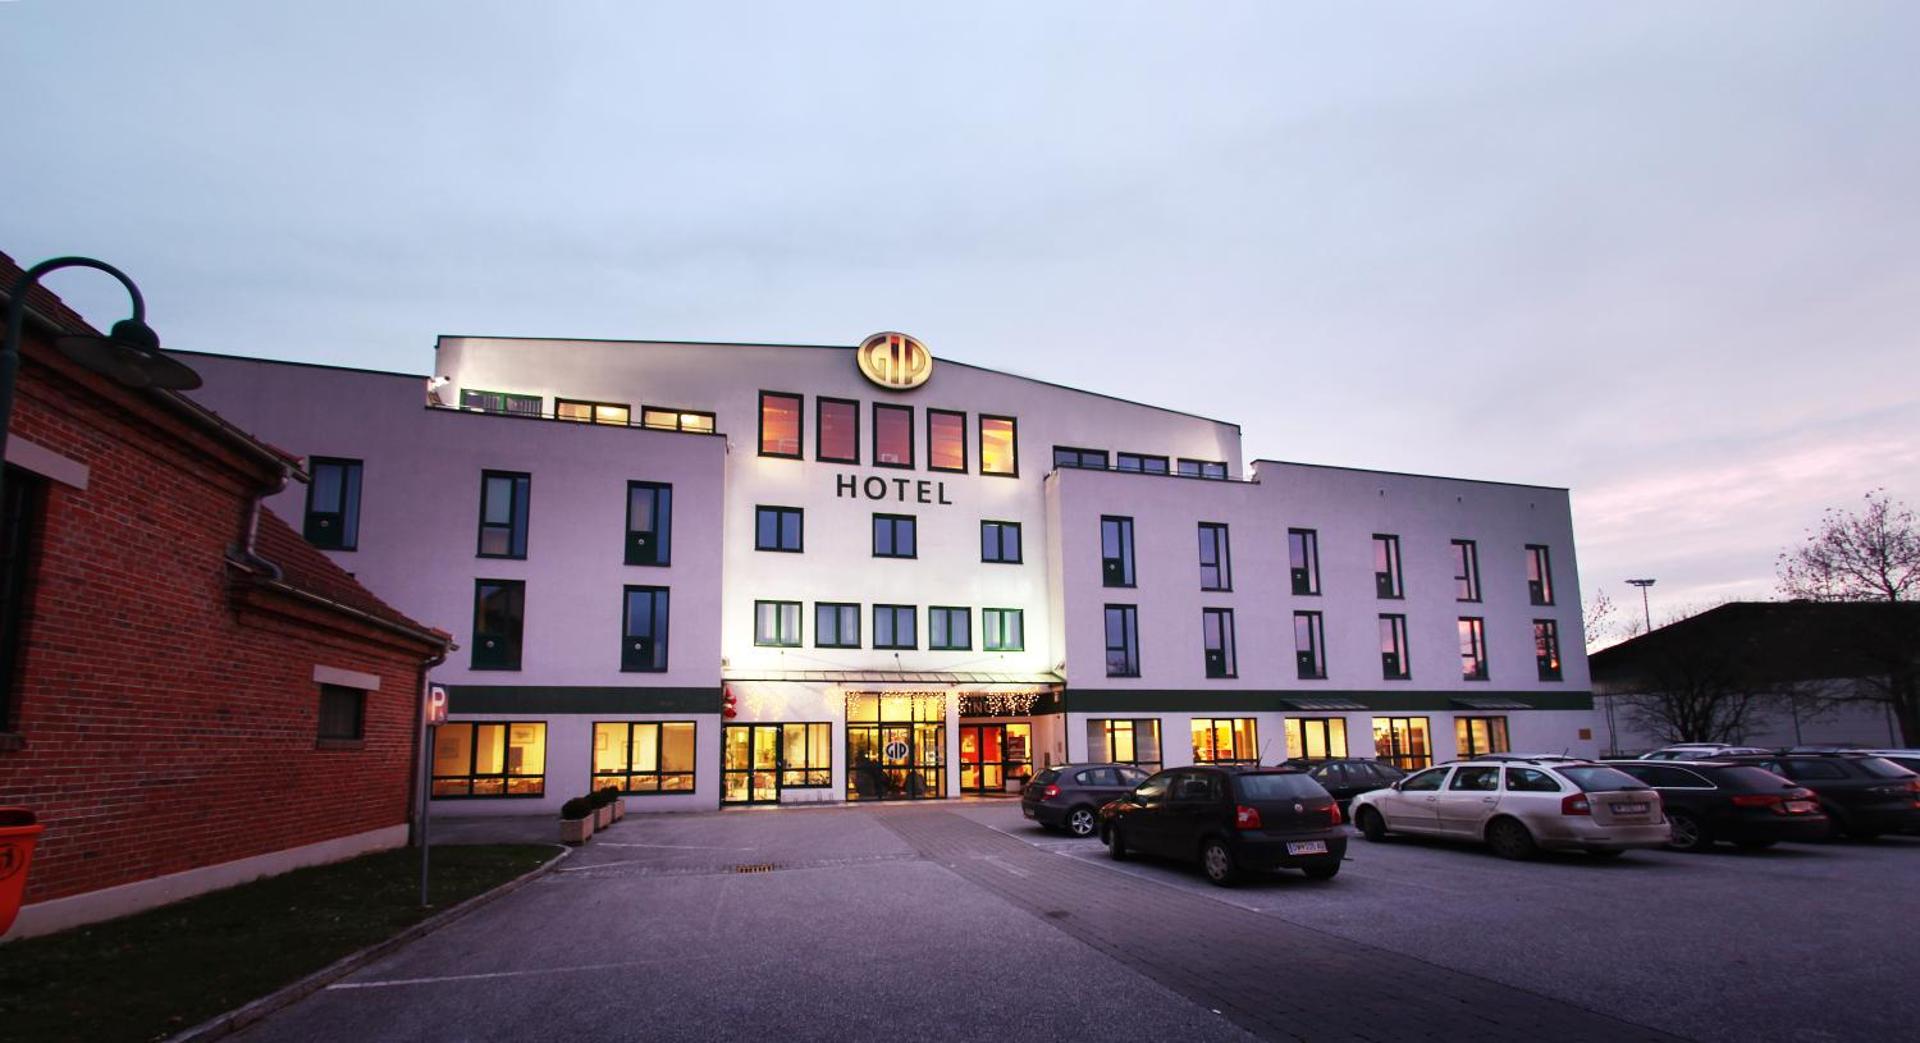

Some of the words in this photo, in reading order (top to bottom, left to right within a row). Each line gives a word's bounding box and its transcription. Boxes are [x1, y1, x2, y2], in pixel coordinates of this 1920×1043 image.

[863, 335, 927, 385] GIP
[837, 474, 952, 505] HOTEL
[431, 687, 446, 721] P
